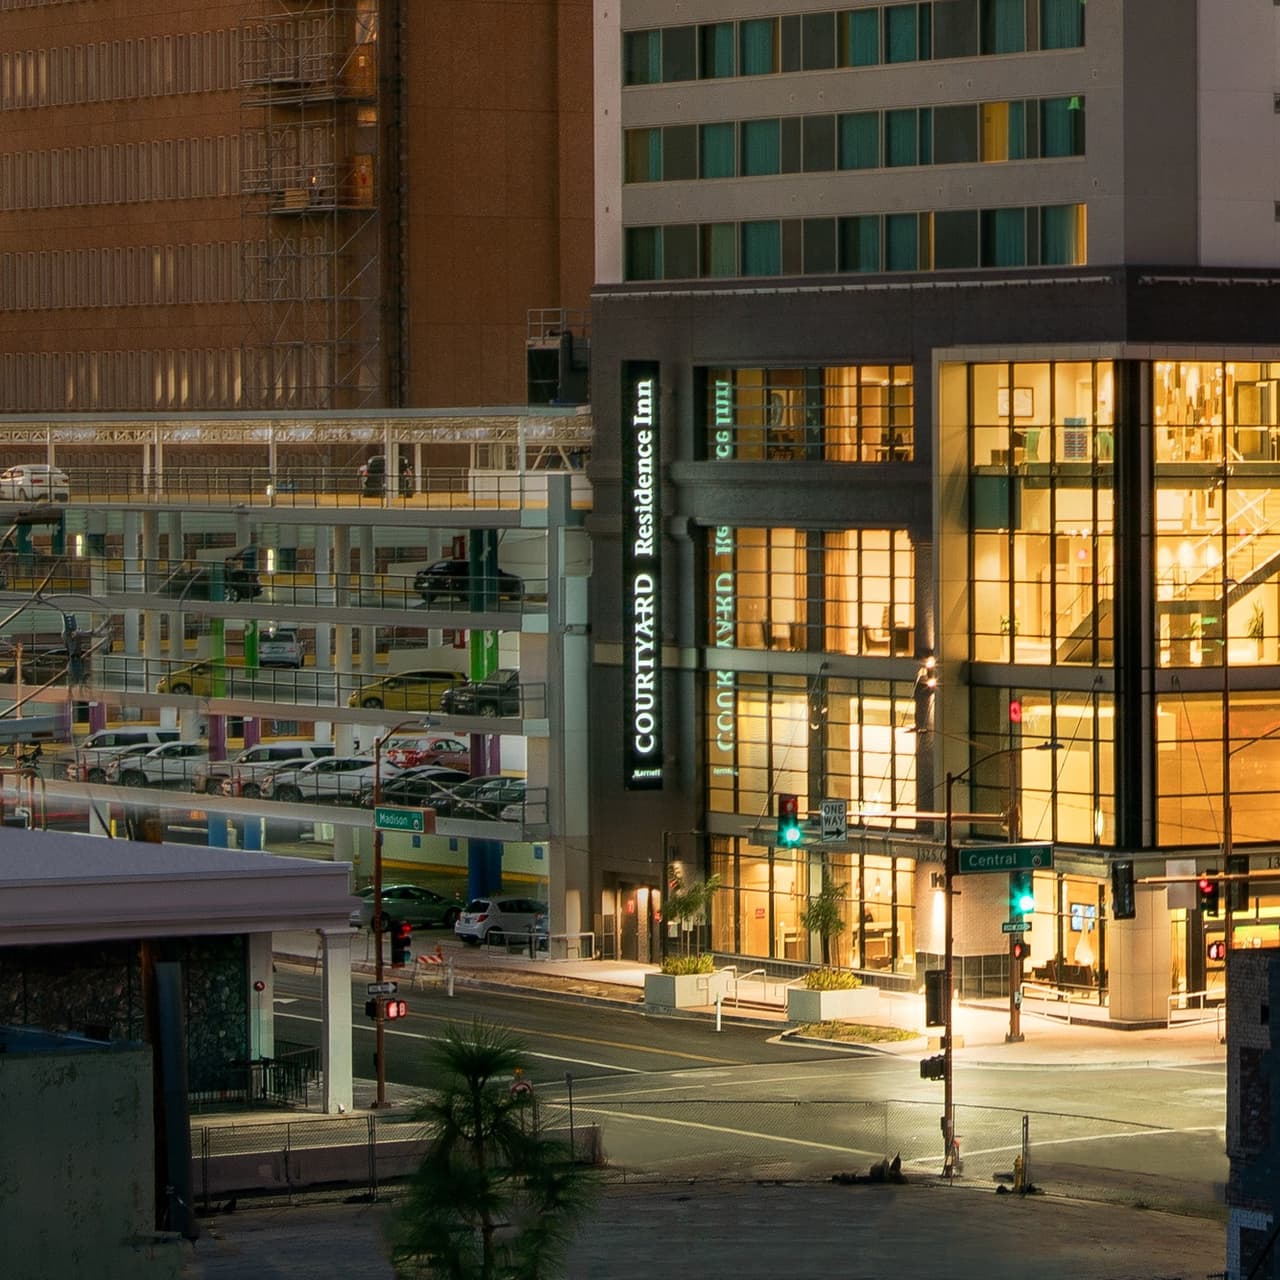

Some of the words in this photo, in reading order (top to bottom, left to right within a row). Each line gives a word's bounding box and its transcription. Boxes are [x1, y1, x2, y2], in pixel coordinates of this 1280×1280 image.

[633, 379, 653, 426] Inn
[634, 429, 654, 557] Residence
[634, 573, 655, 754] COURTYARD
[824, 804, 844, 815] ONE
[379, 812, 409, 825] Madison
[824, 815, 844, 827] WAY
[968, 853, 1017, 867] Central
